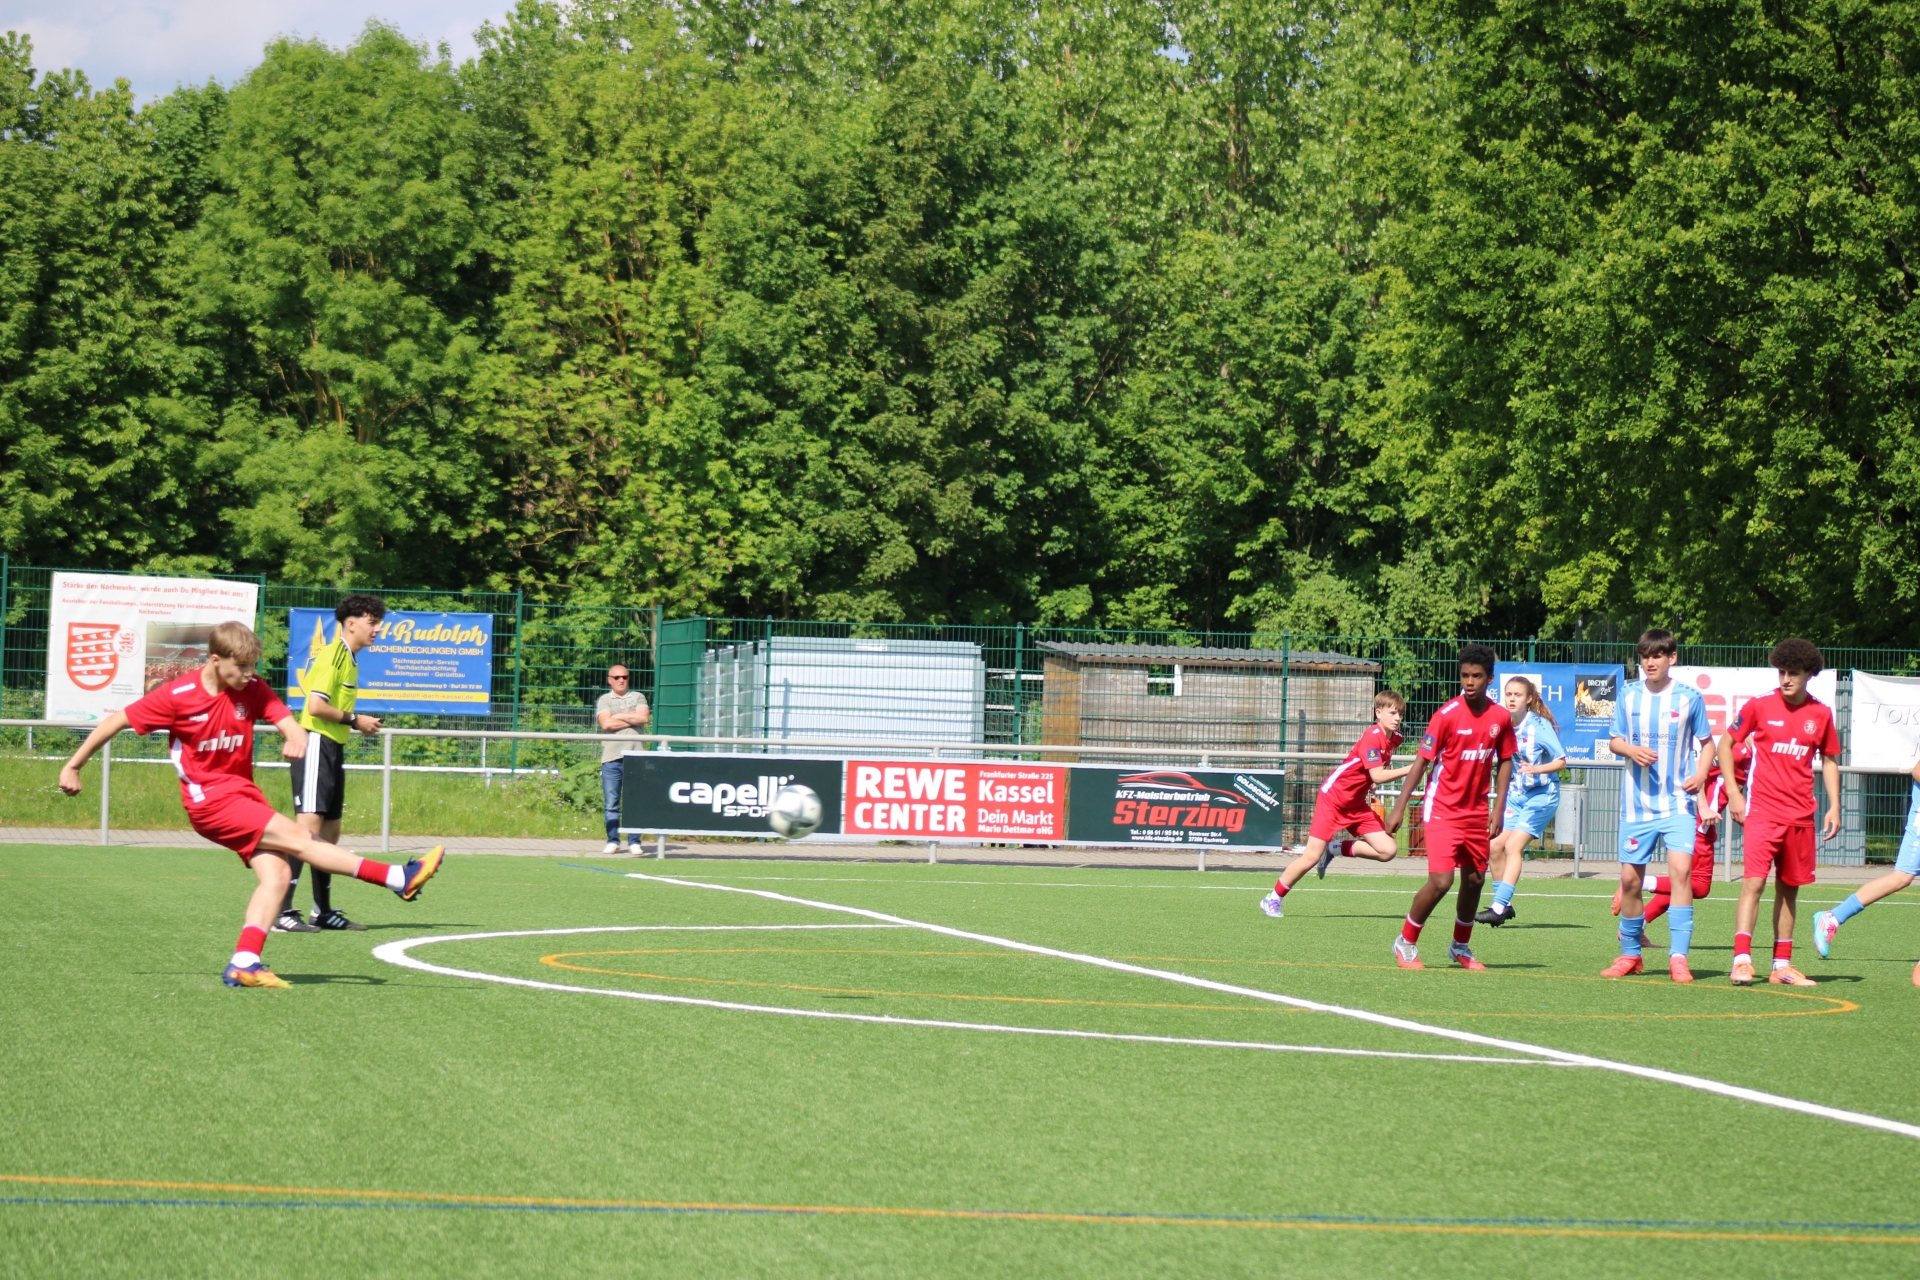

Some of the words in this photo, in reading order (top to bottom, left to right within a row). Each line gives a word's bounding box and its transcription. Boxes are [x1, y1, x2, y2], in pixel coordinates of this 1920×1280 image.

[63, 581, 84, 589] Stärke
[86, 582, 99, 590] den
[100, 583, 139, 593] Nachwuchs,
[141, 585, 162, 593] werde
[180, 586, 190, 594] Du
[191, 587, 218, 596] Mitglied
[369, 645, 456, 655] DACHEINDECKUNGEN
[458, 648, 484, 656] GMBH
[385, 670, 429, 678] Bauklempnerei
[394, 664, 457, 673] Flachdachabdichtung
[197, 729, 244, 753] mhp
[1565, 745, 1590, 753] Vellmar
[1771, 737, 1810, 761] mhp
[1461, 743, 1493, 763] mhp
[856, 766, 966, 801] REWE
[979, 770, 1017, 779] Frankfurter
[1017, 771, 1040, 780] Straße
[978, 779, 1055, 804] Kassel
[1115, 790, 1211, 802] KFZ-Meisterbetrieb
[1236, 775, 1280, 807] GOLDSCHMITT
[854, 802, 966, 833] CENTER
[978, 808, 1008, 824] Dein
[1011, 809, 1054, 825] Markt
[1113, 800, 1247, 833] Sterzing
[978, 824, 1002, 833] Mario
[1002, 825, 1035, 834] Dettmar
[1036, 826, 1054, 835] oHG
